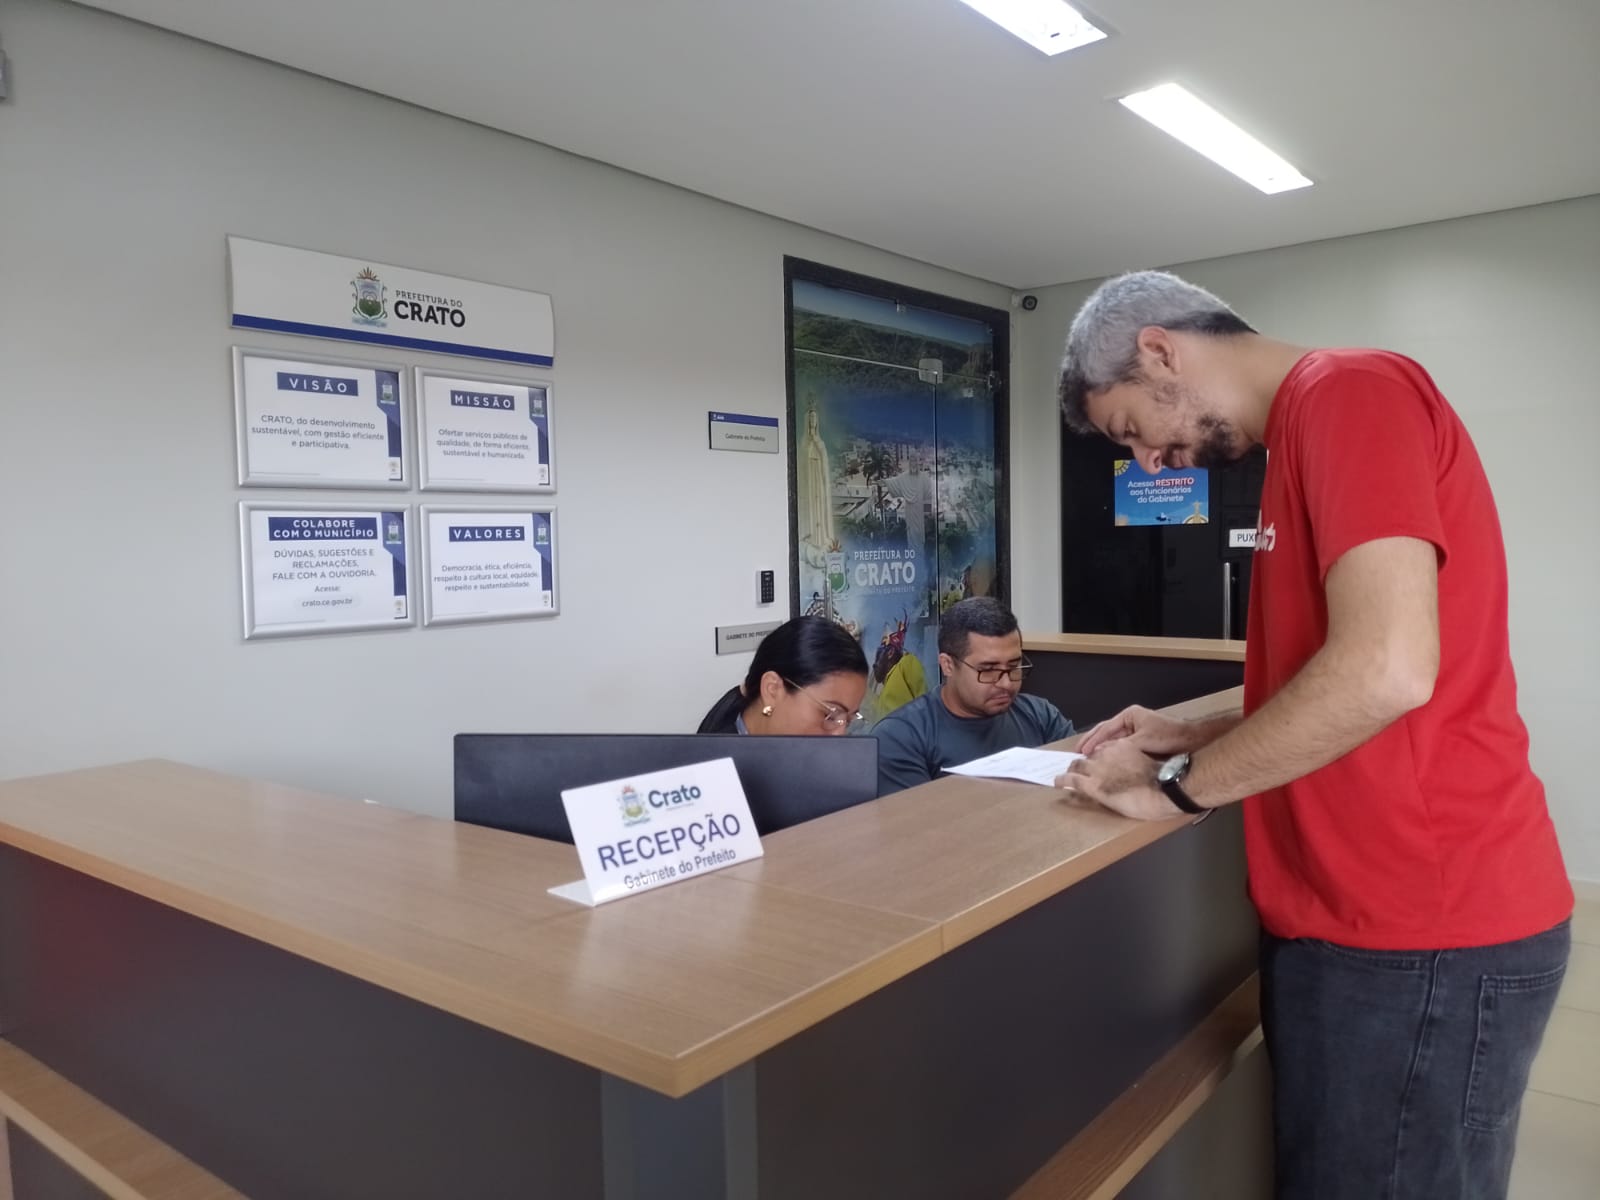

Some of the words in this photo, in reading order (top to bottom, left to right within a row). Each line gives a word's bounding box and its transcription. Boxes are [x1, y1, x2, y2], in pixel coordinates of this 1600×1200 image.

[396, 290, 448, 306] PREFEITURA
[450, 299, 462, 308] DO
[394, 300, 465, 327] CRATO
[289, 377, 348, 393] VISÃO
[454, 394, 512, 408] MISSÃO
[261, 414, 294, 425] CRATO,
[310, 418, 376, 430] desenvolvimento
[324, 430, 351, 439] gestão
[352, 431, 384, 440] eficiente
[438, 428, 463, 437] Ofertar
[465, 430, 492, 440] serviços
[493, 432, 518, 440] públicos
[443, 449, 480, 457] sustentável
[1155, 477, 1194, 487] RESTRITO
[1130, 488, 1144, 496] aos
[1145, 486, 1192, 495] funcionários
[1138, 496, 1147, 504] do
[1149, 494, 1184, 503] Gabinete
[293, 520, 355, 528] COLABORE
[273, 530, 299, 538] COM
[303, 530, 311, 538] O
[315, 527, 374, 538] MUNICÍPIO
[454, 529, 521, 539] VALORES
[274, 548, 316, 558] DÚVIDAS,
[318, 548, 367, 557] SUGESTÕES
[369, 548, 374, 556] E
[854, 550, 900, 561] PREFEITURA
[904, 550, 915, 559] DO
[272, 572, 294, 581] FALE
[297, 571, 317, 579] COM
[469, 573, 491, 581] cultura
[854, 561, 915, 586] CRATO
[648, 784, 701, 808] Crato
[597, 812, 740, 872] RECEPÇÃO
[624, 866, 676, 890] Gabinete
[678, 861, 693, 875] do
[695, 848, 736, 868] Prefeito
